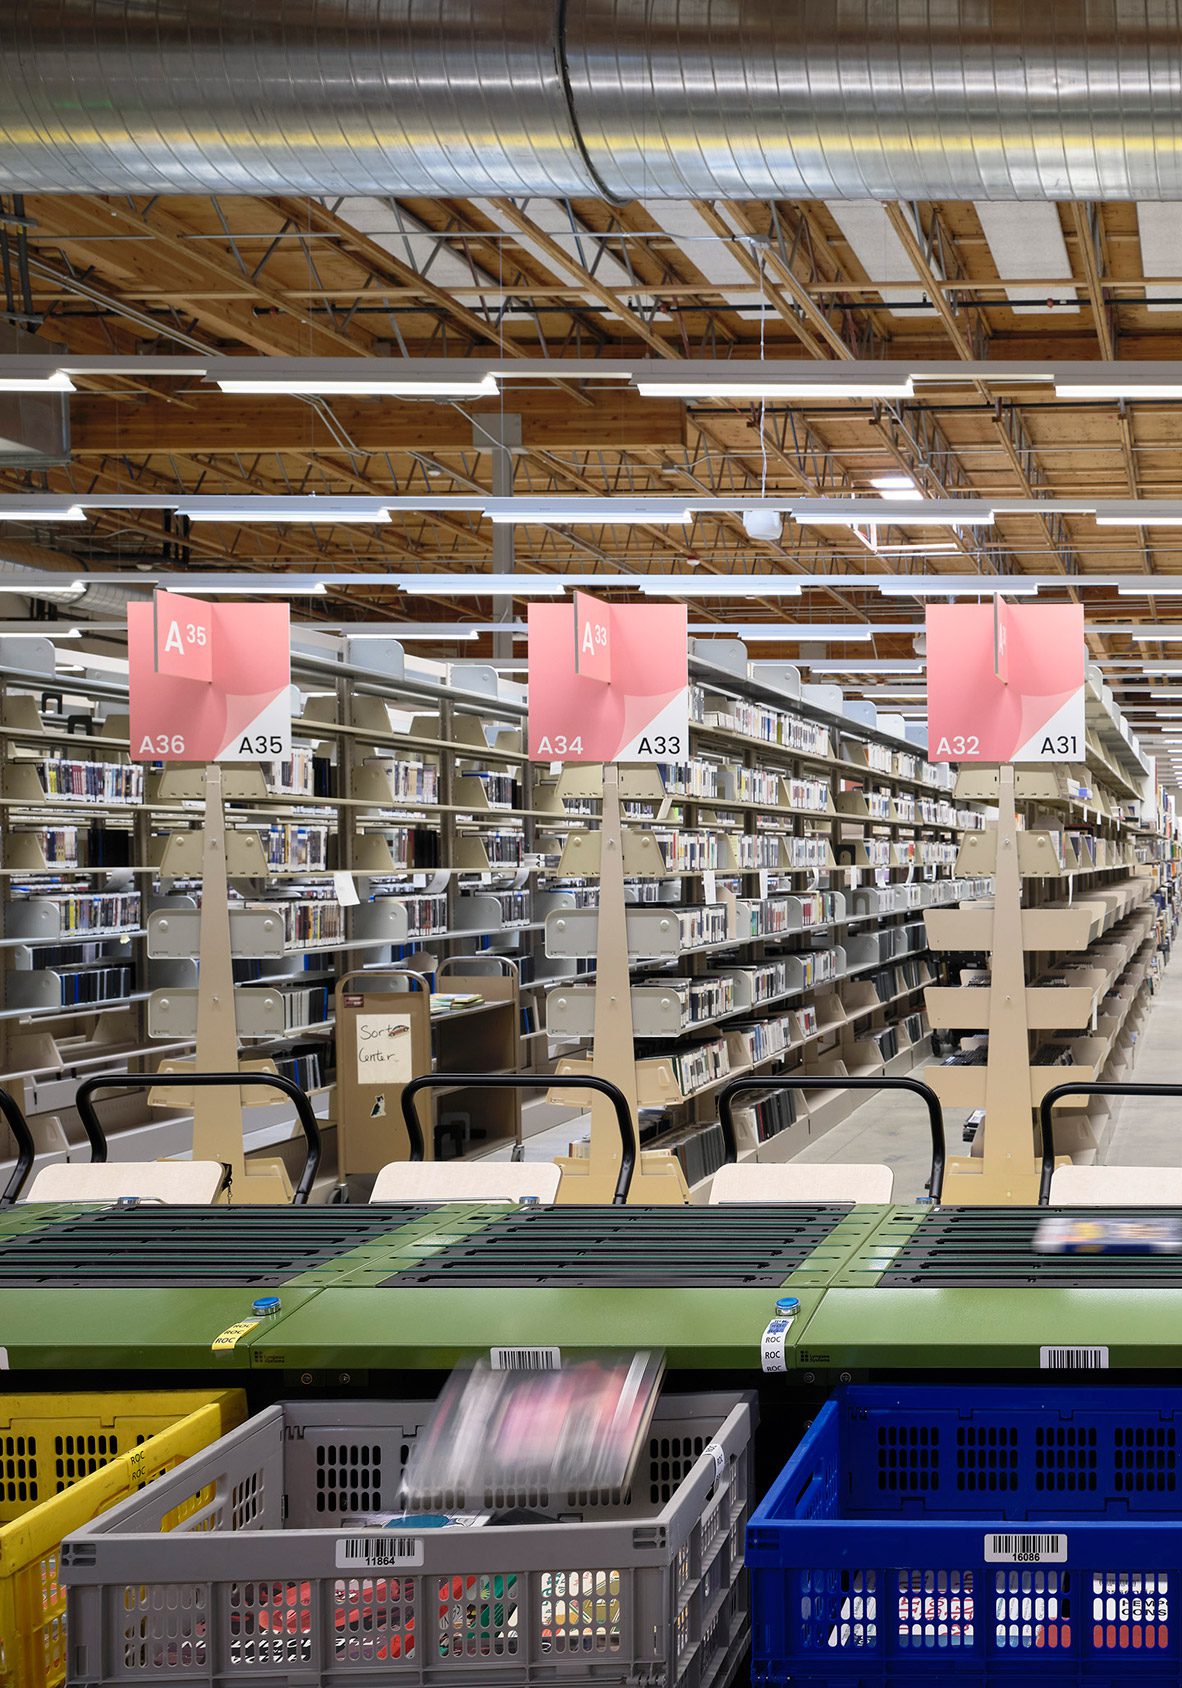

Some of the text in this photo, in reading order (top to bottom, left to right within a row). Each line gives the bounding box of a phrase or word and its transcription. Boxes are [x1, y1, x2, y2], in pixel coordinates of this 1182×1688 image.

[164, 620, 207, 655] A35
[582, 621, 607, 656] A33
[139, 734, 185, 754] A36
[238, 735, 283, 754] A35
[537, 735, 584, 755] A34
[637, 736, 681, 755] A33
[936, 735, 980, 755] A32
[1040, 736, 1077, 754] A31
[765, 1350, 781, 1359] ROC
[130, 1450, 145, 1466] ROC
[132, 1465, 146, 1480] ROC
[365, 1556, 396, 1566] 11864
[1012, 1552, 1040, 1562] 16086
